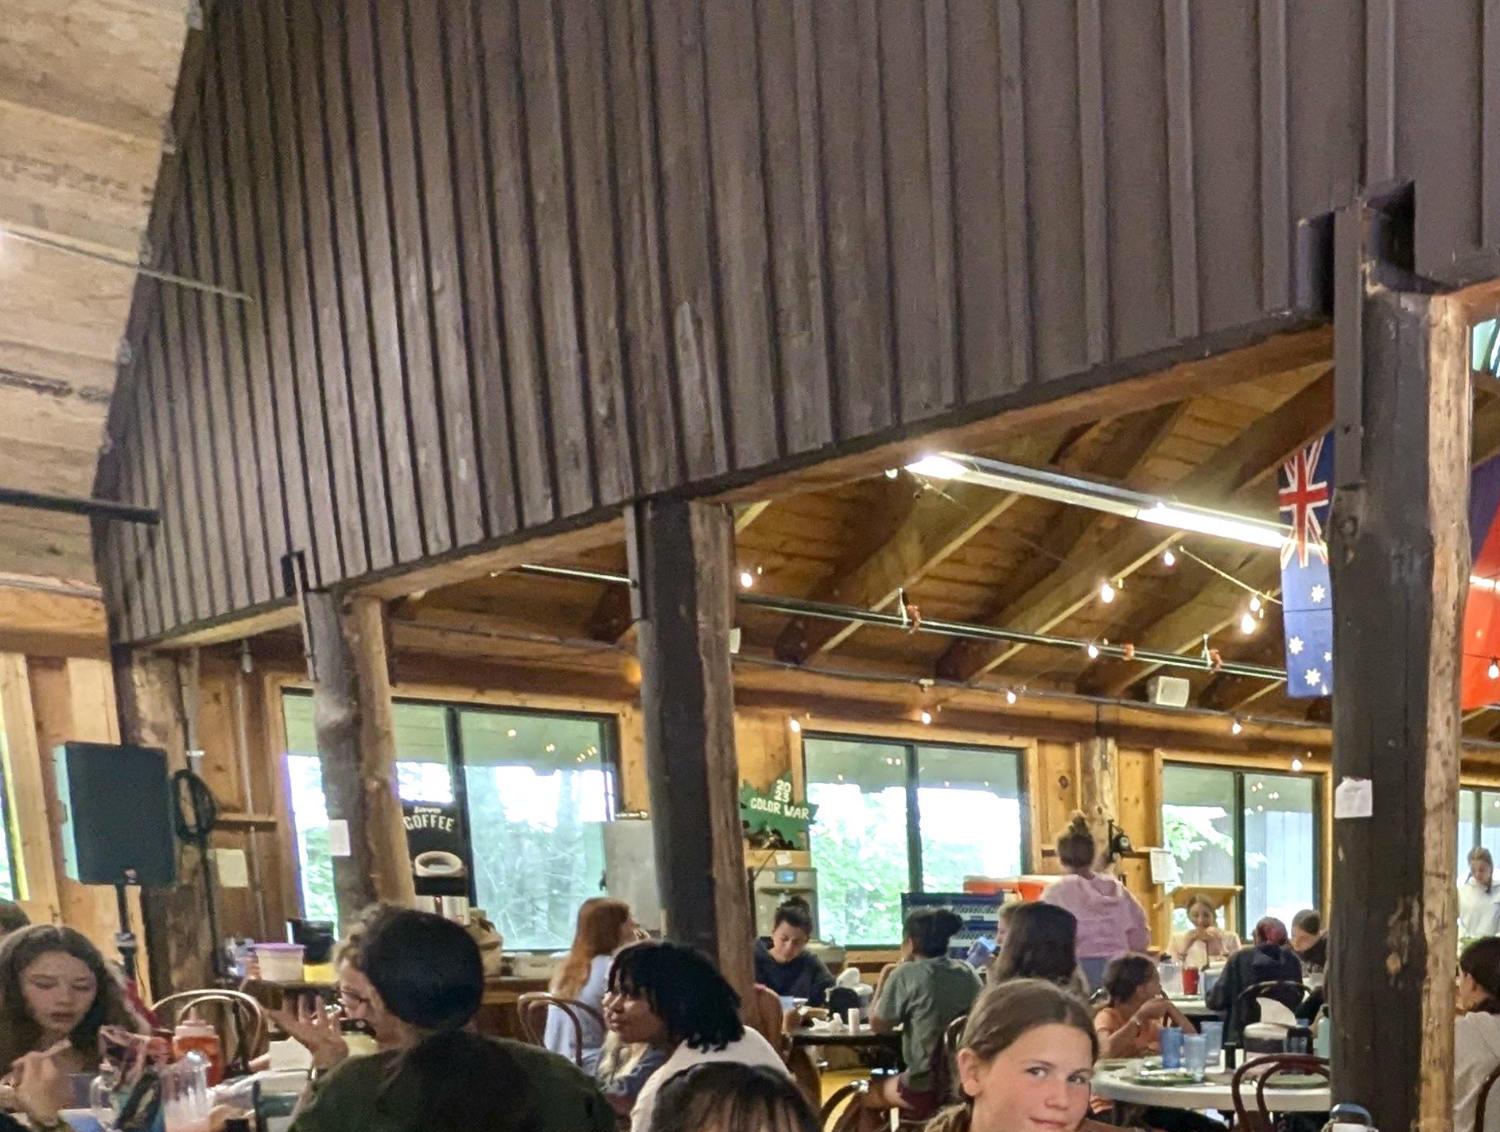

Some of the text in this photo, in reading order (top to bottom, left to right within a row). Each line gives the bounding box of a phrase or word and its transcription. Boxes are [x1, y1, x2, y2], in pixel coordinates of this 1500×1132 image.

[776, 779, 792, 793] 20
[774, 790, 790, 803] 23
[750, 797, 809, 820] COLOR WAR
[403, 814, 455, 832] COFFEE
